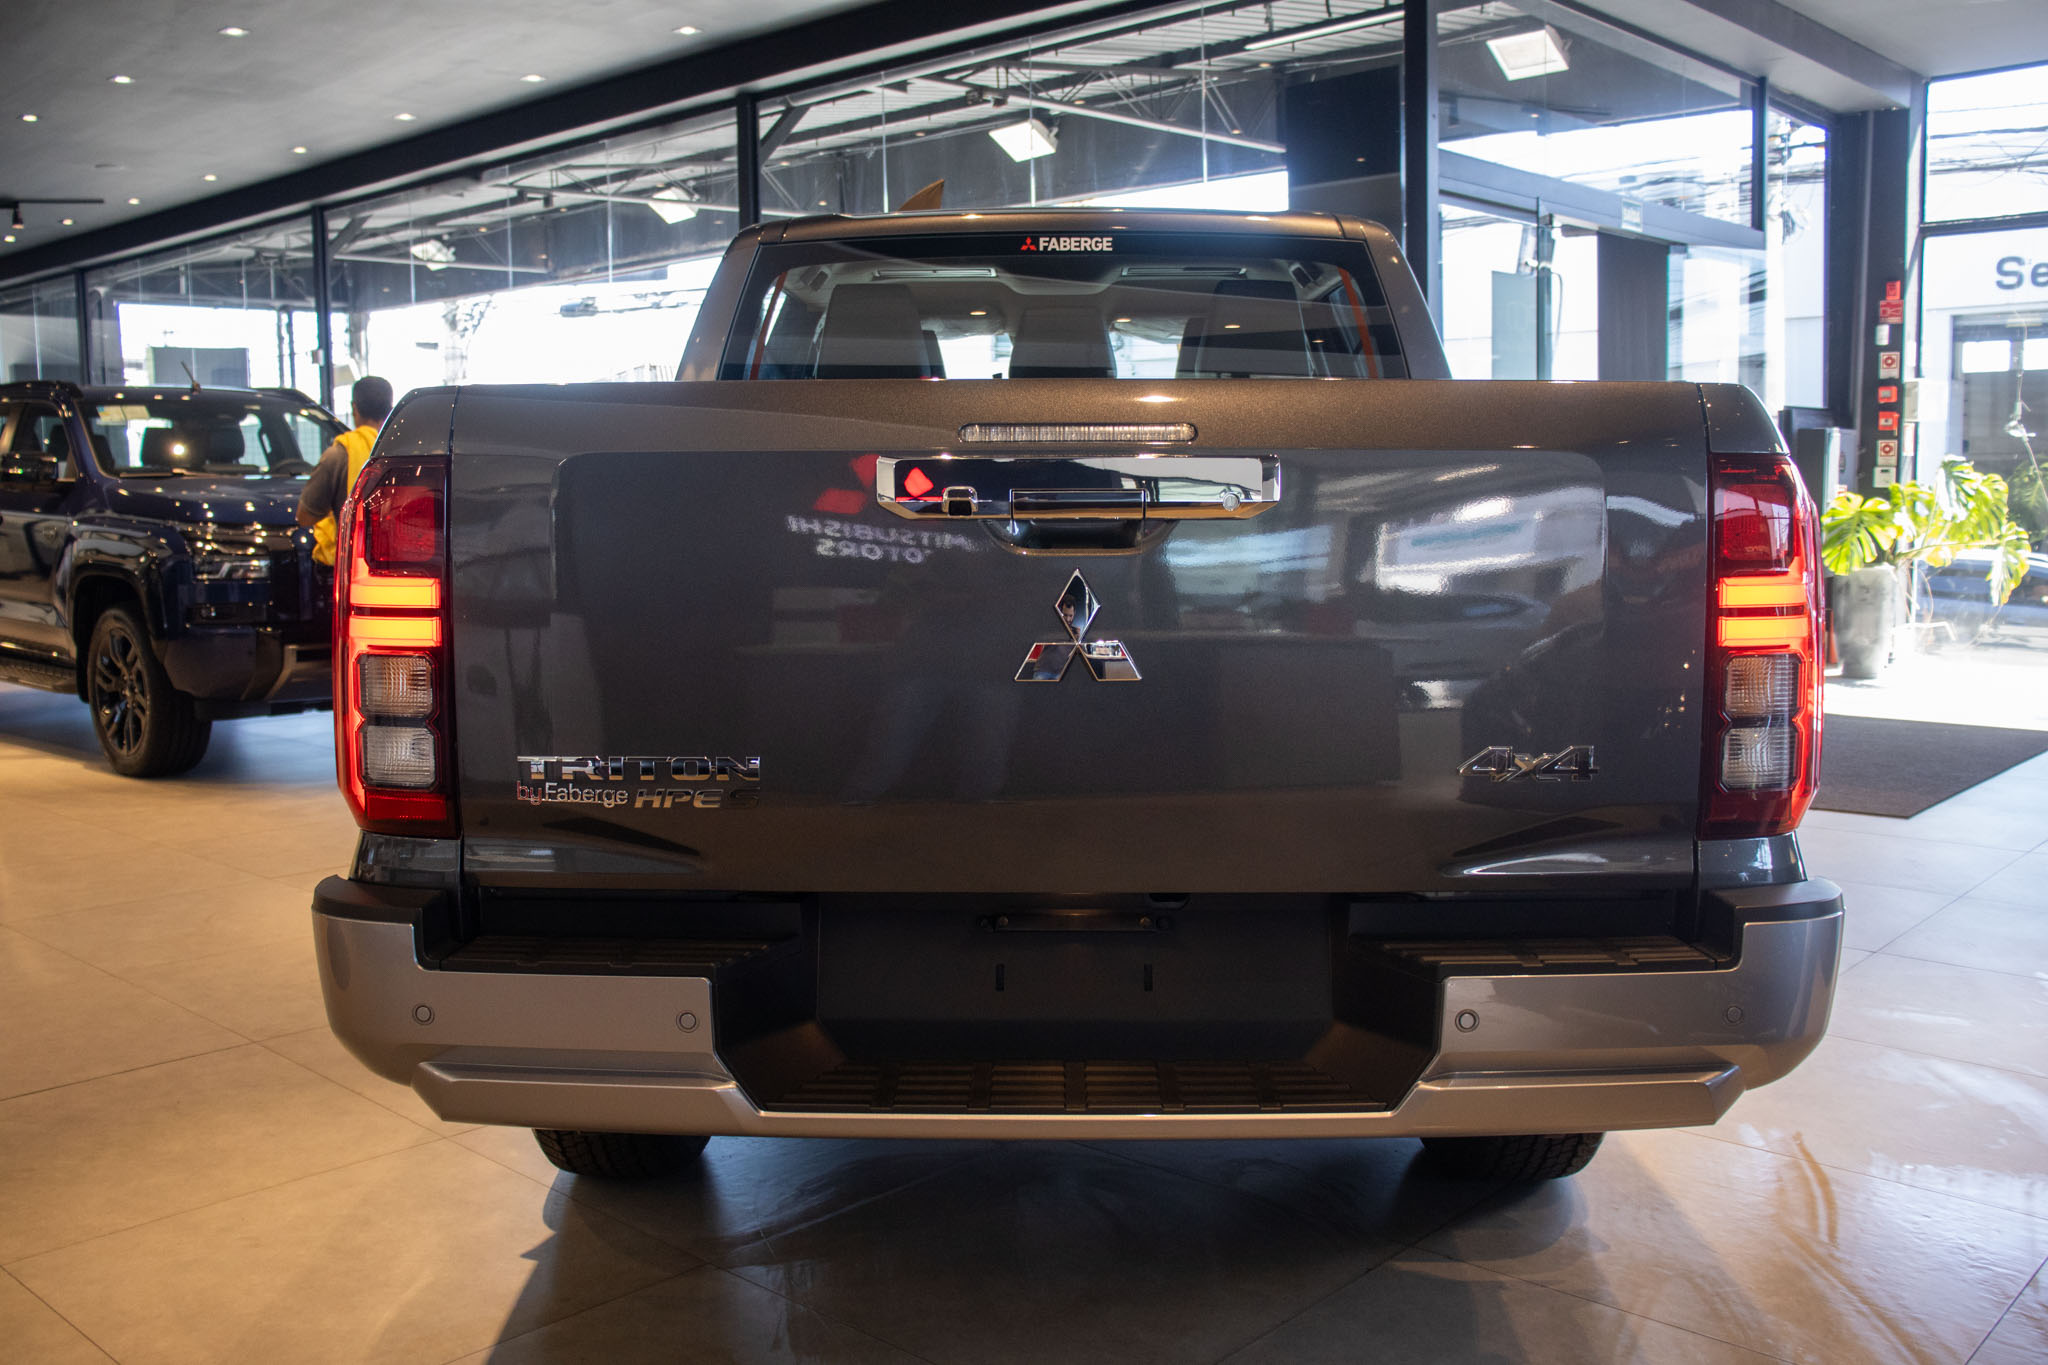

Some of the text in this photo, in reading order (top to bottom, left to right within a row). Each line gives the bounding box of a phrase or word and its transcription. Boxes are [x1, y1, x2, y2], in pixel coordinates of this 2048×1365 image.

[1039, 236, 1113, 252] FABERGE
[517, 756, 760, 781] TRITON
[1457, 746, 1599, 782] 4x4
